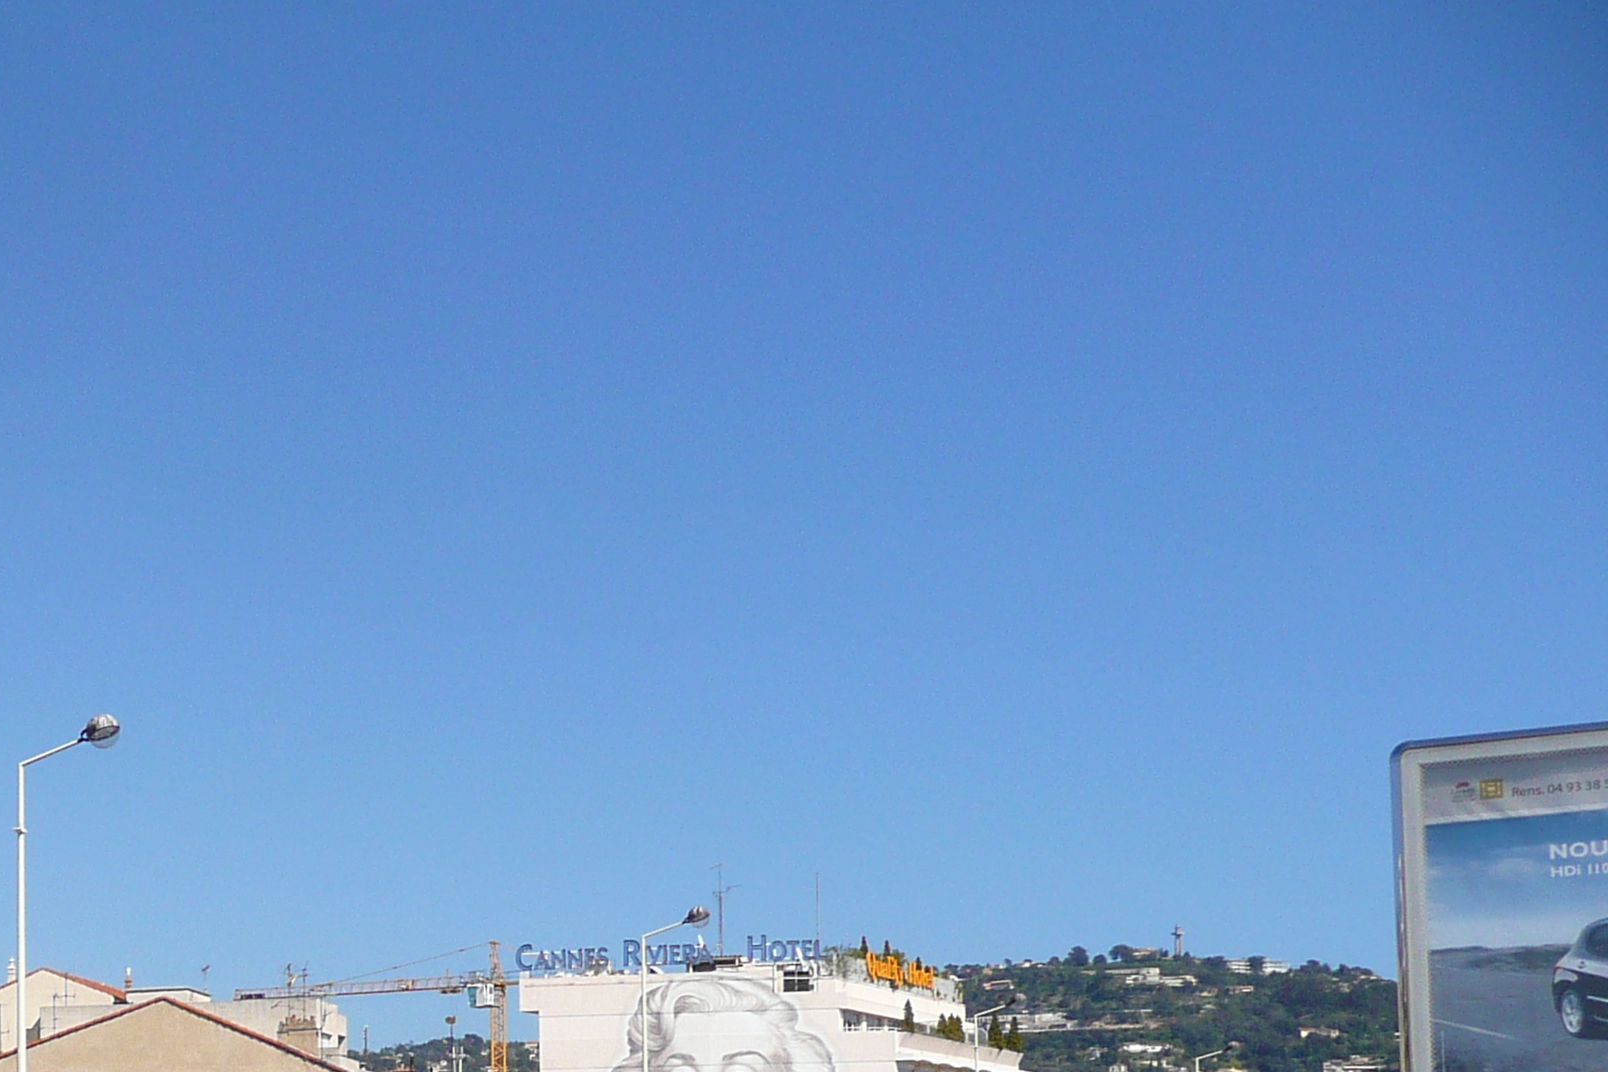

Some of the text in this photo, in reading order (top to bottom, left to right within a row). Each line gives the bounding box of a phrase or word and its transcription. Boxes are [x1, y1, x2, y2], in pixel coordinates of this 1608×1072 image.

[1547, 783, 1563, 795] 04
[1566, 781, 1582, 792] 93
[1585, 779, 1601, 791] 38
[1550, 864, 1581, 878] HDi
[515, 934, 827, 971] CANNES RVIERA HOTEL
[866, 951, 935, 988] Quality Hotel
